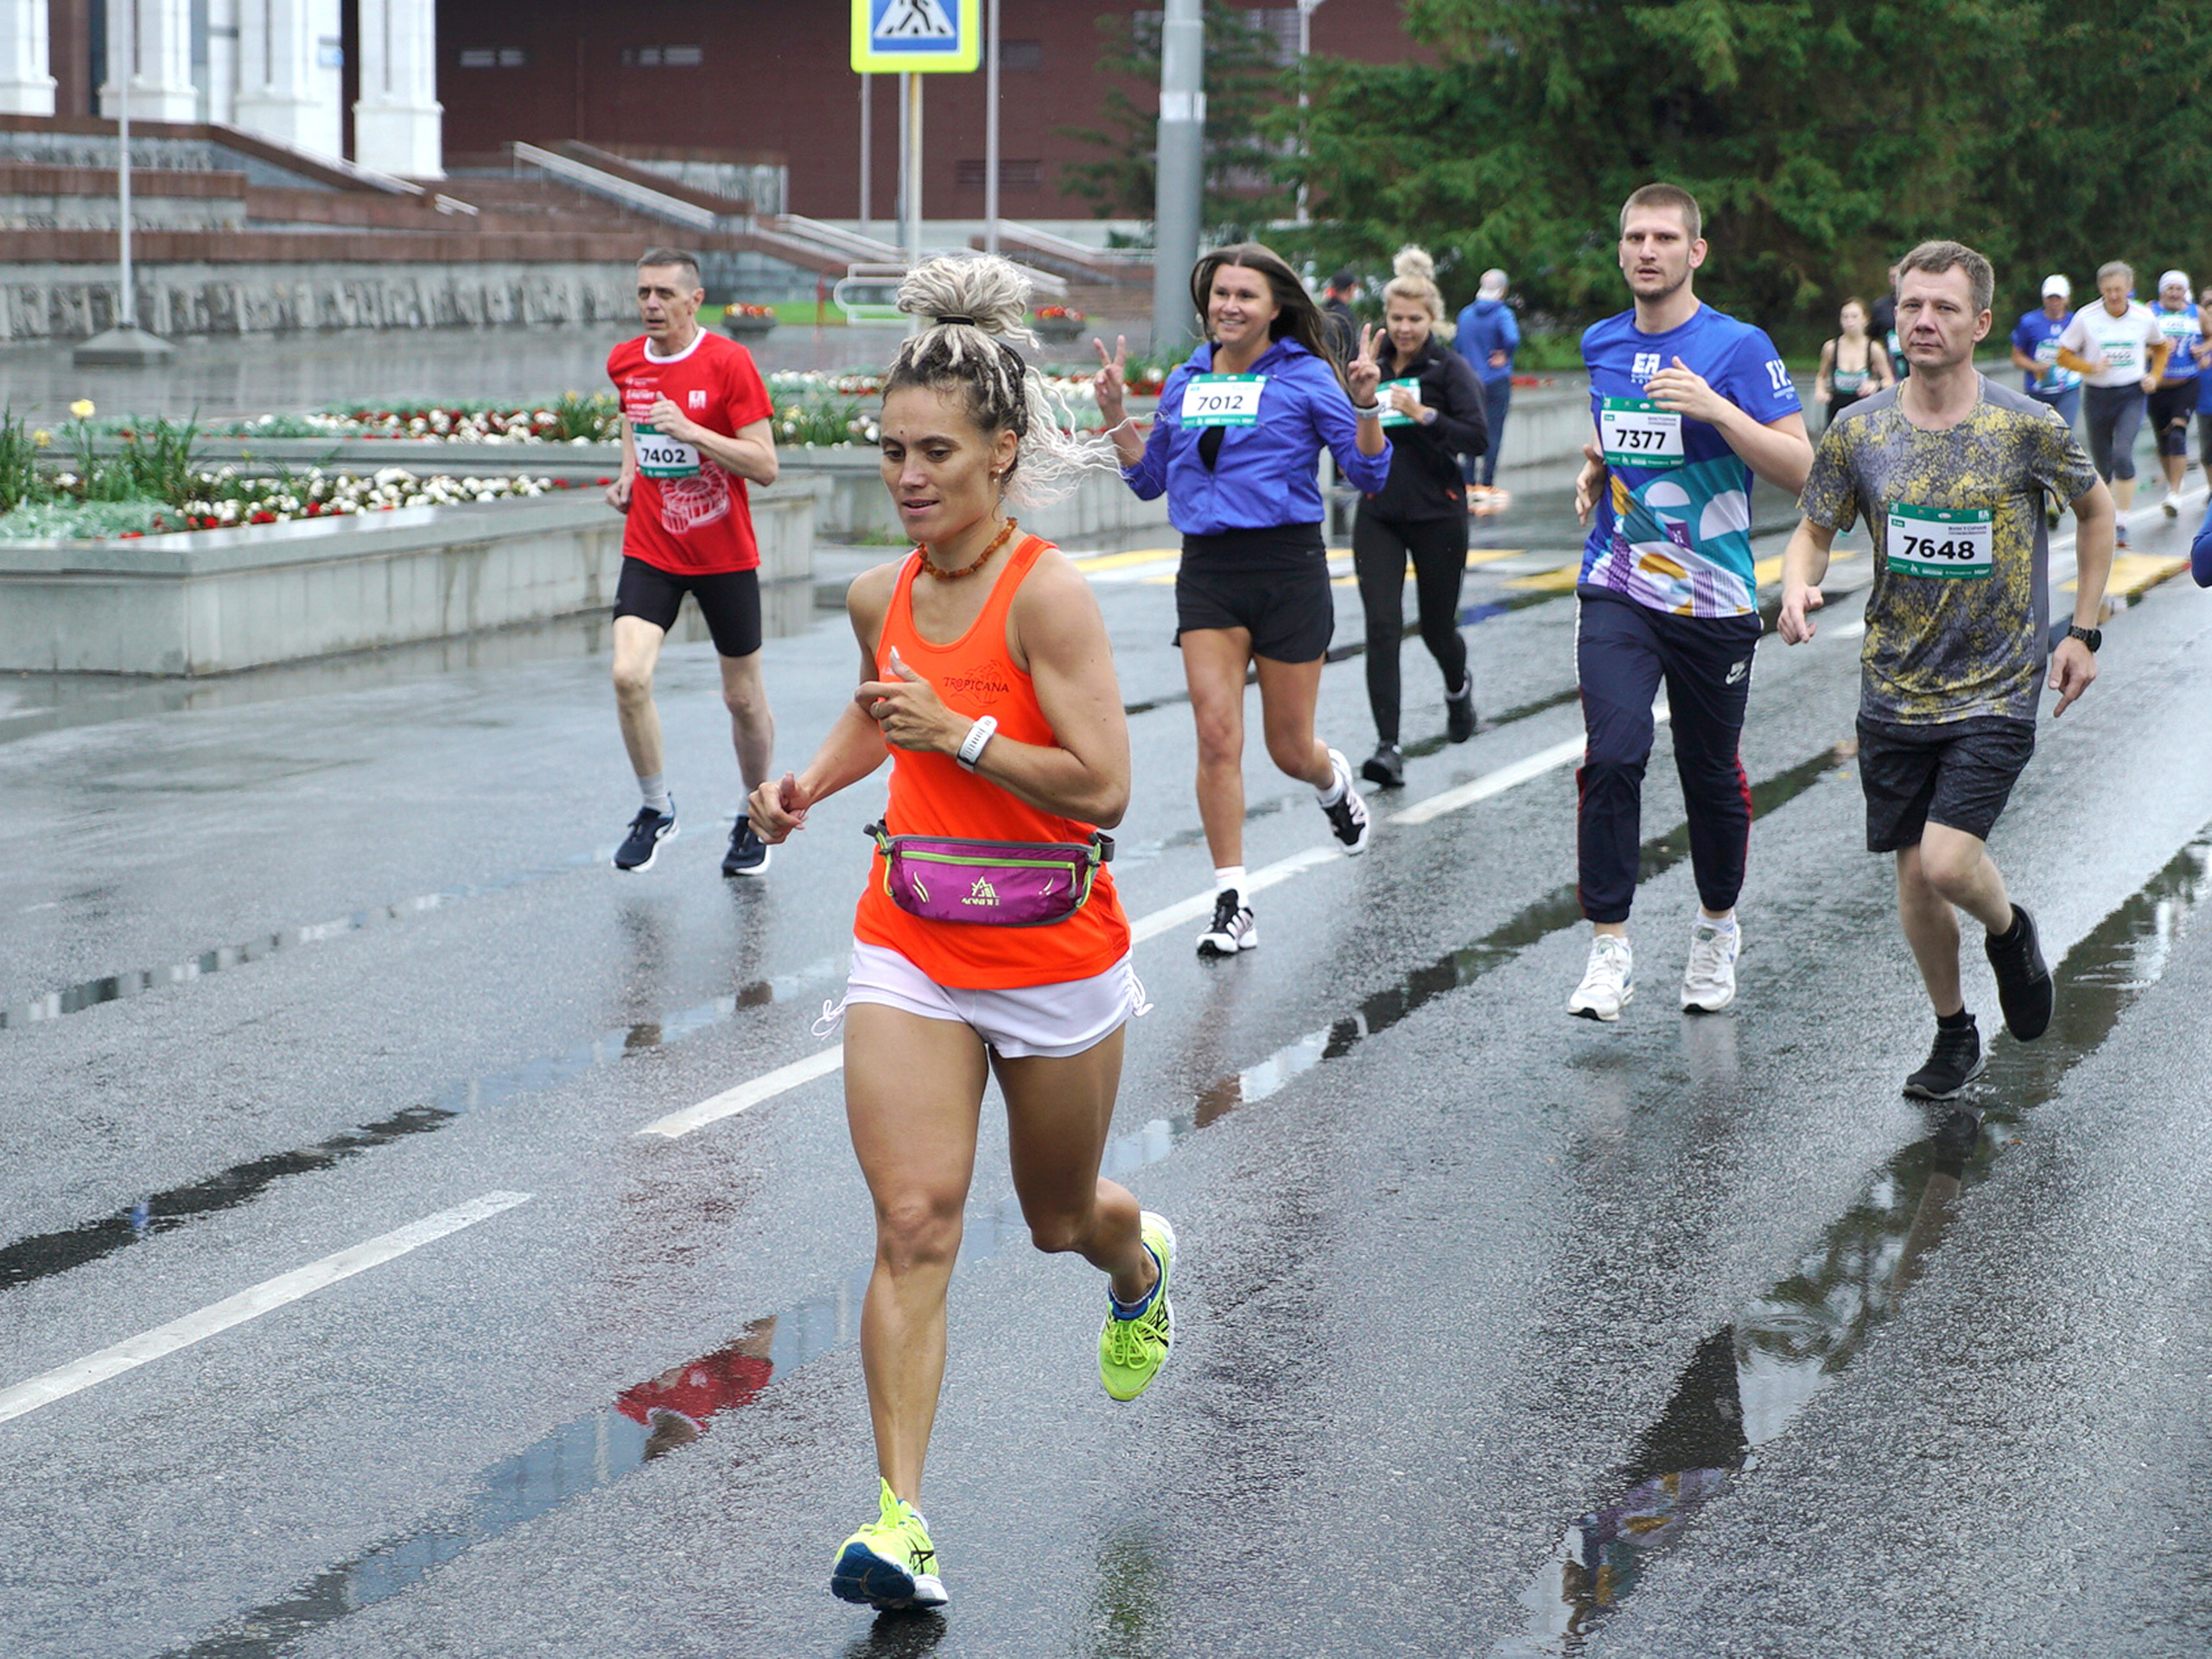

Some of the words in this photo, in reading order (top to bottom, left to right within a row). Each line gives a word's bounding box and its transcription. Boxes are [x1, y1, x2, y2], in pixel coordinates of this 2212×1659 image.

[1197, 395, 1243, 410] 7012
[1615, 429, 1667, 450] 7377
[641, 448, 686, 464] 7402
[1903, 535, 1975, 560] 7648
[943, 677, 1009, 693] TROPICANA
